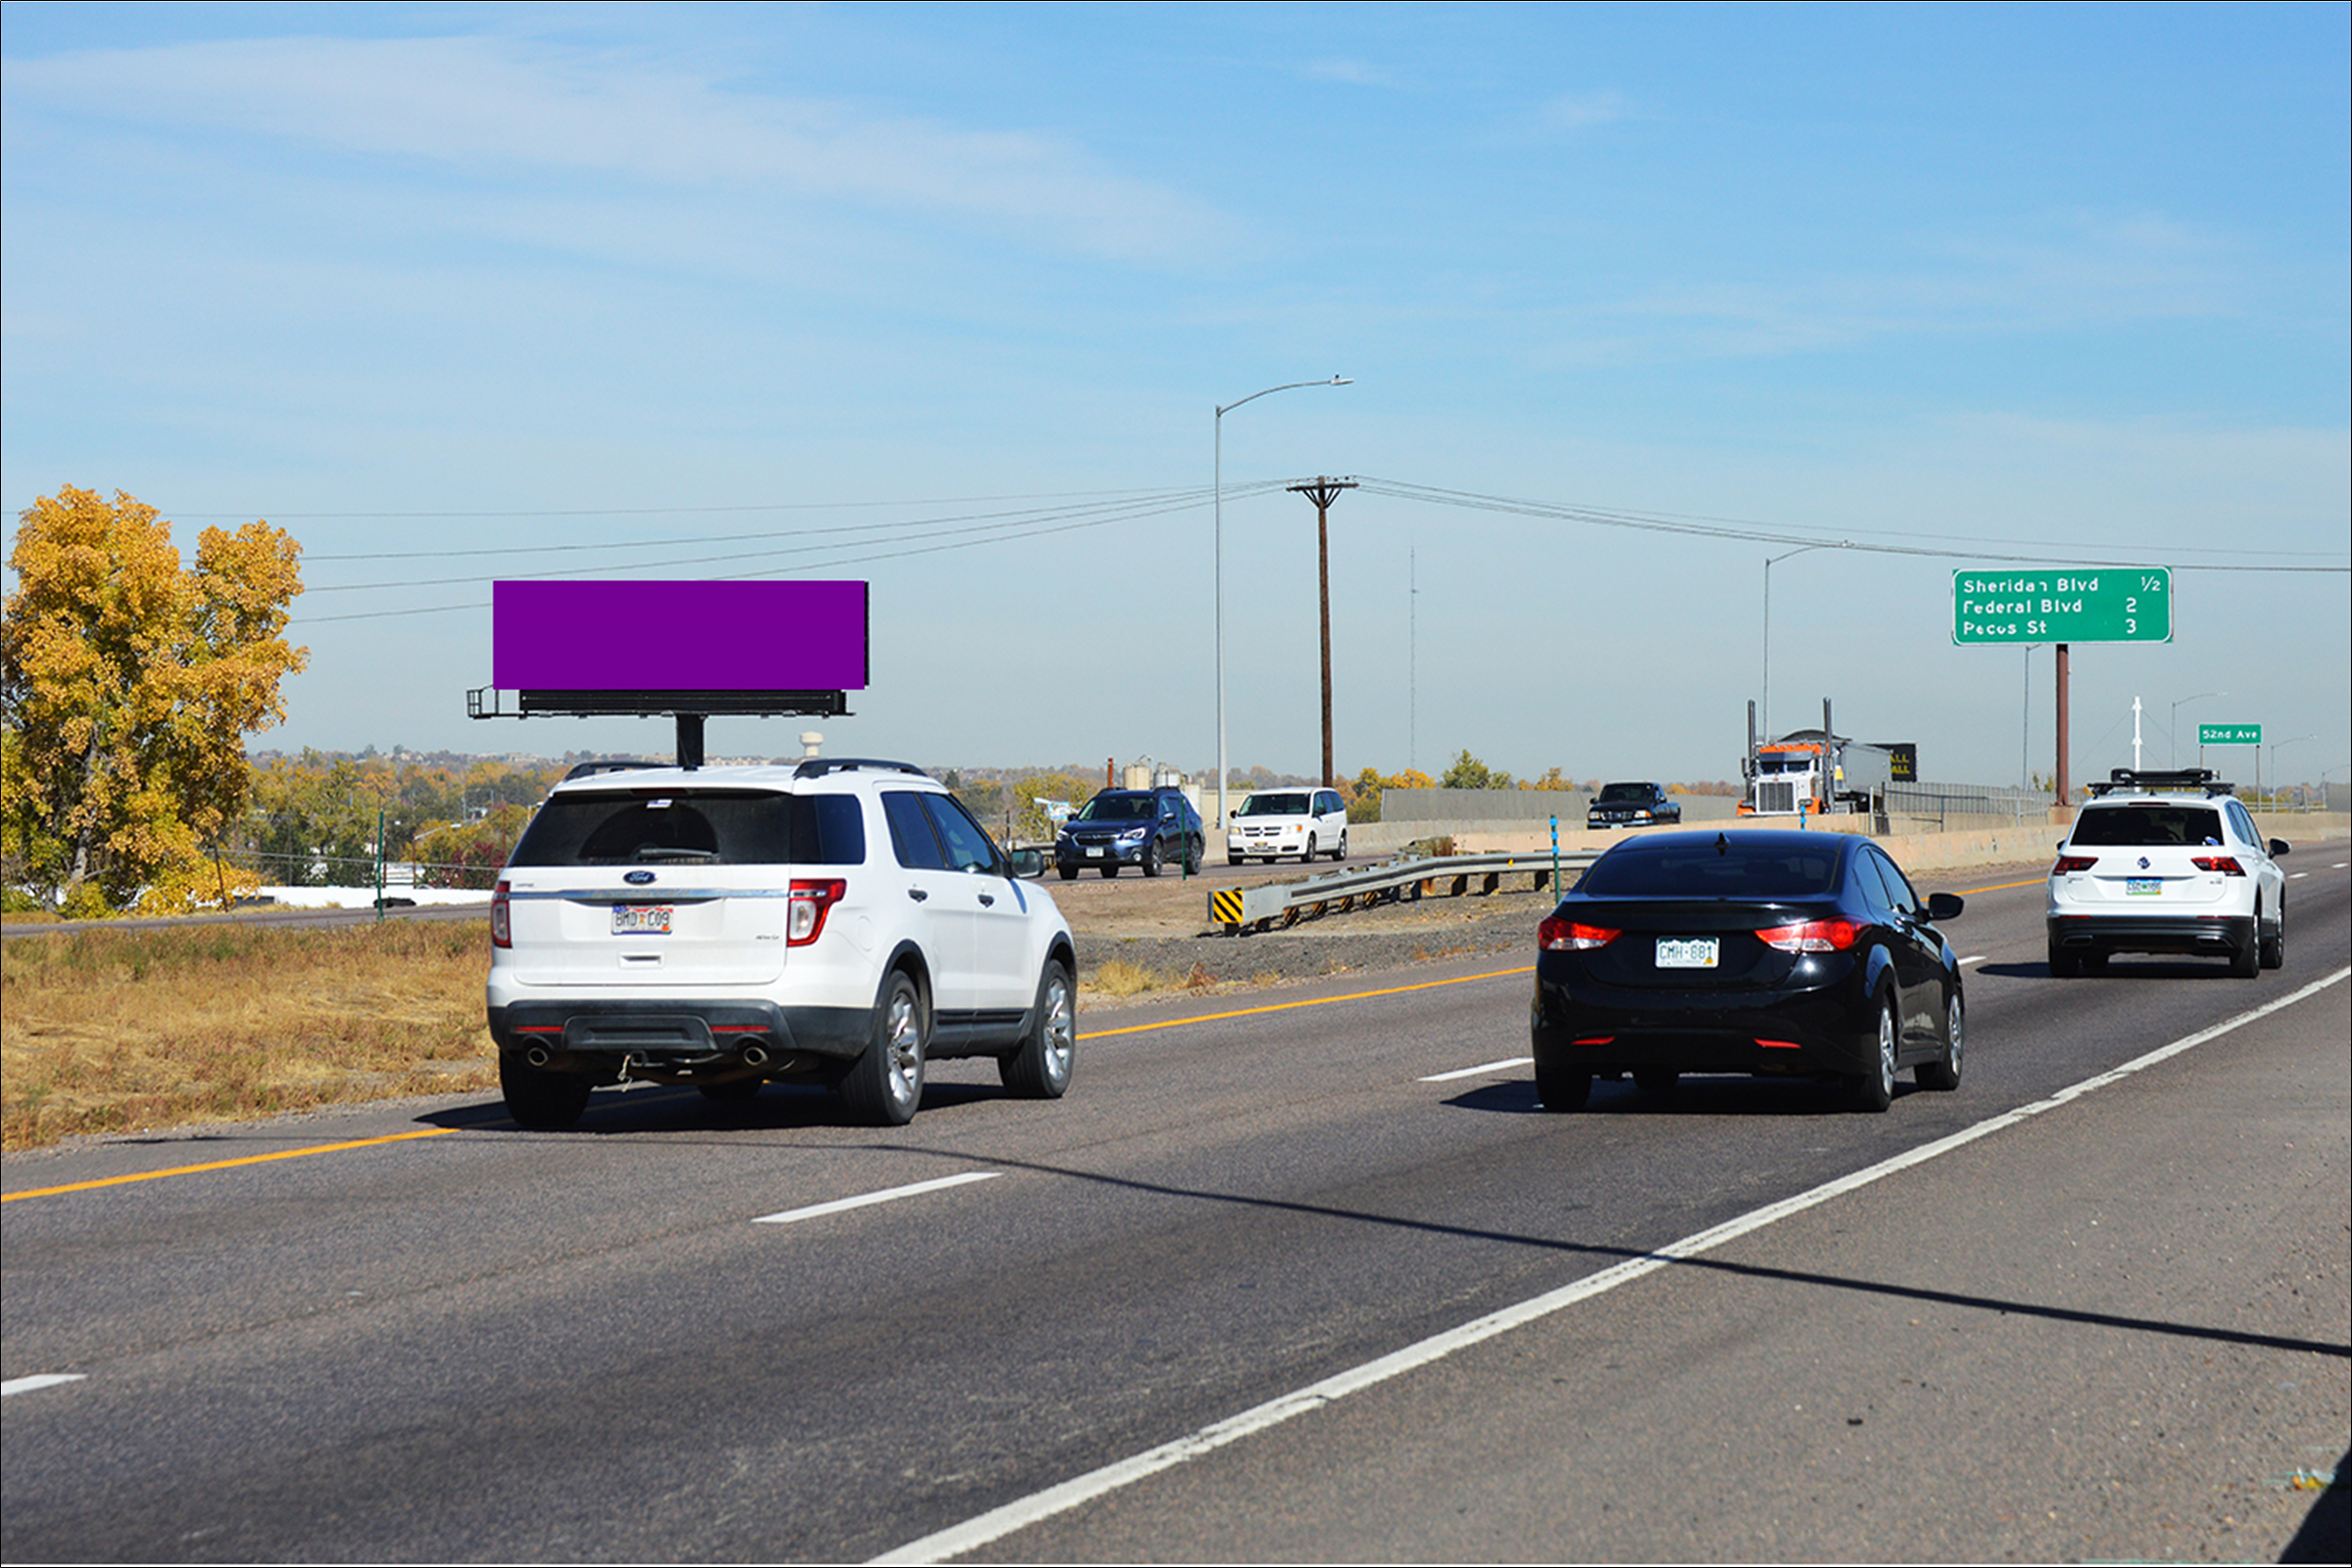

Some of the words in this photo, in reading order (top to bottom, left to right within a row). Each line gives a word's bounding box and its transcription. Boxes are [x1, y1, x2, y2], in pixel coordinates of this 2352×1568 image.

[1964, 578, 2048, 594] Sheridan
[2057, 577, 2099, 592] Blvd
[1963, 600, 2032, 614] Federal
[2040, 599, 2082, 613] Blvd
[2126, 597, 2137, 613] 2
[1963, 620, 2018, 635] Pecos
[2027, 619, 2047, 635] St
[2126, 617, 2137, 634] 3
[2202, 729, 2231, 740] 52nd
[2236, 729, 2258, 740] Ave
